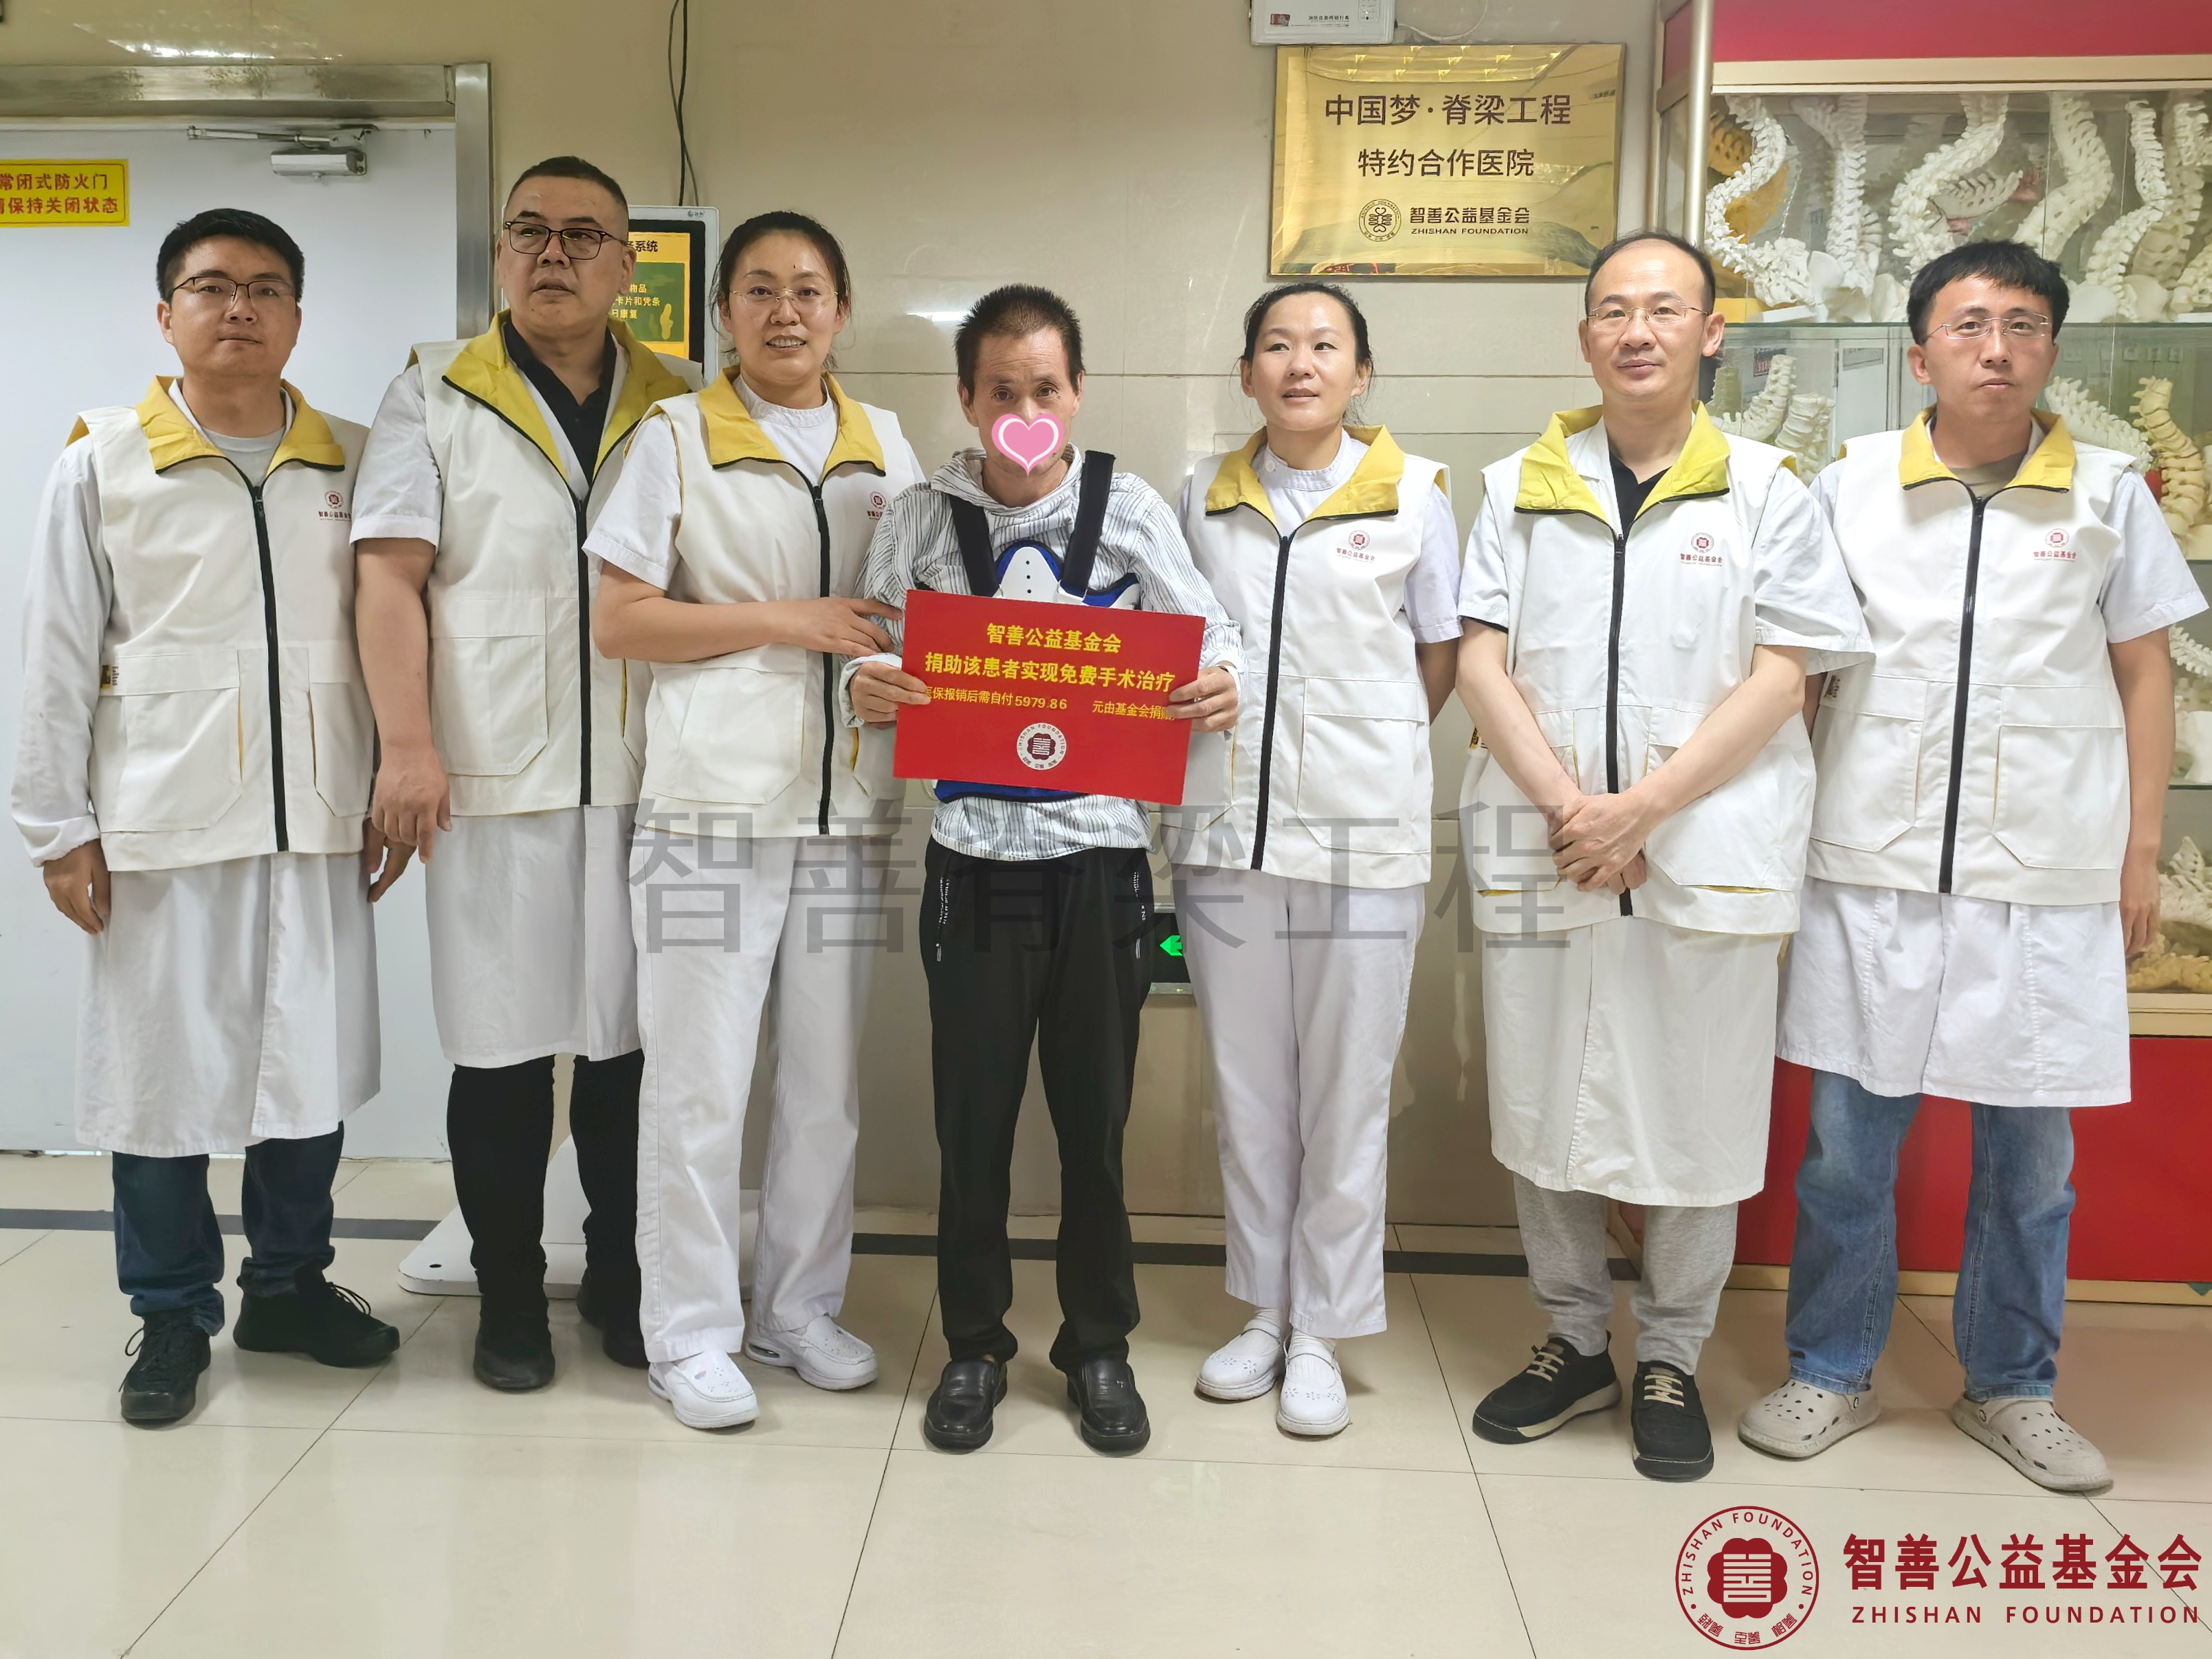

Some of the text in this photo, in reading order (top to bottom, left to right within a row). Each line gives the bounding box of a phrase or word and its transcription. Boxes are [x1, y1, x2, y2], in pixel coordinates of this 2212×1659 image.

[1325, 93, 1571, 125] 中国梦·脊梁工程
[1358, 148, 1534, 177] 特约合作医院
[0, 173, 108, 190] 常闭式防火门
[1410, 207, 1529, 224] 智善公益基金会
[612, 297, 660, 307] 卡片和凭条
[986, 623, 1122, 654] 智善公益基金会
[925, 652, 1175, 693] 捐助该患者实现免费手术治疗
